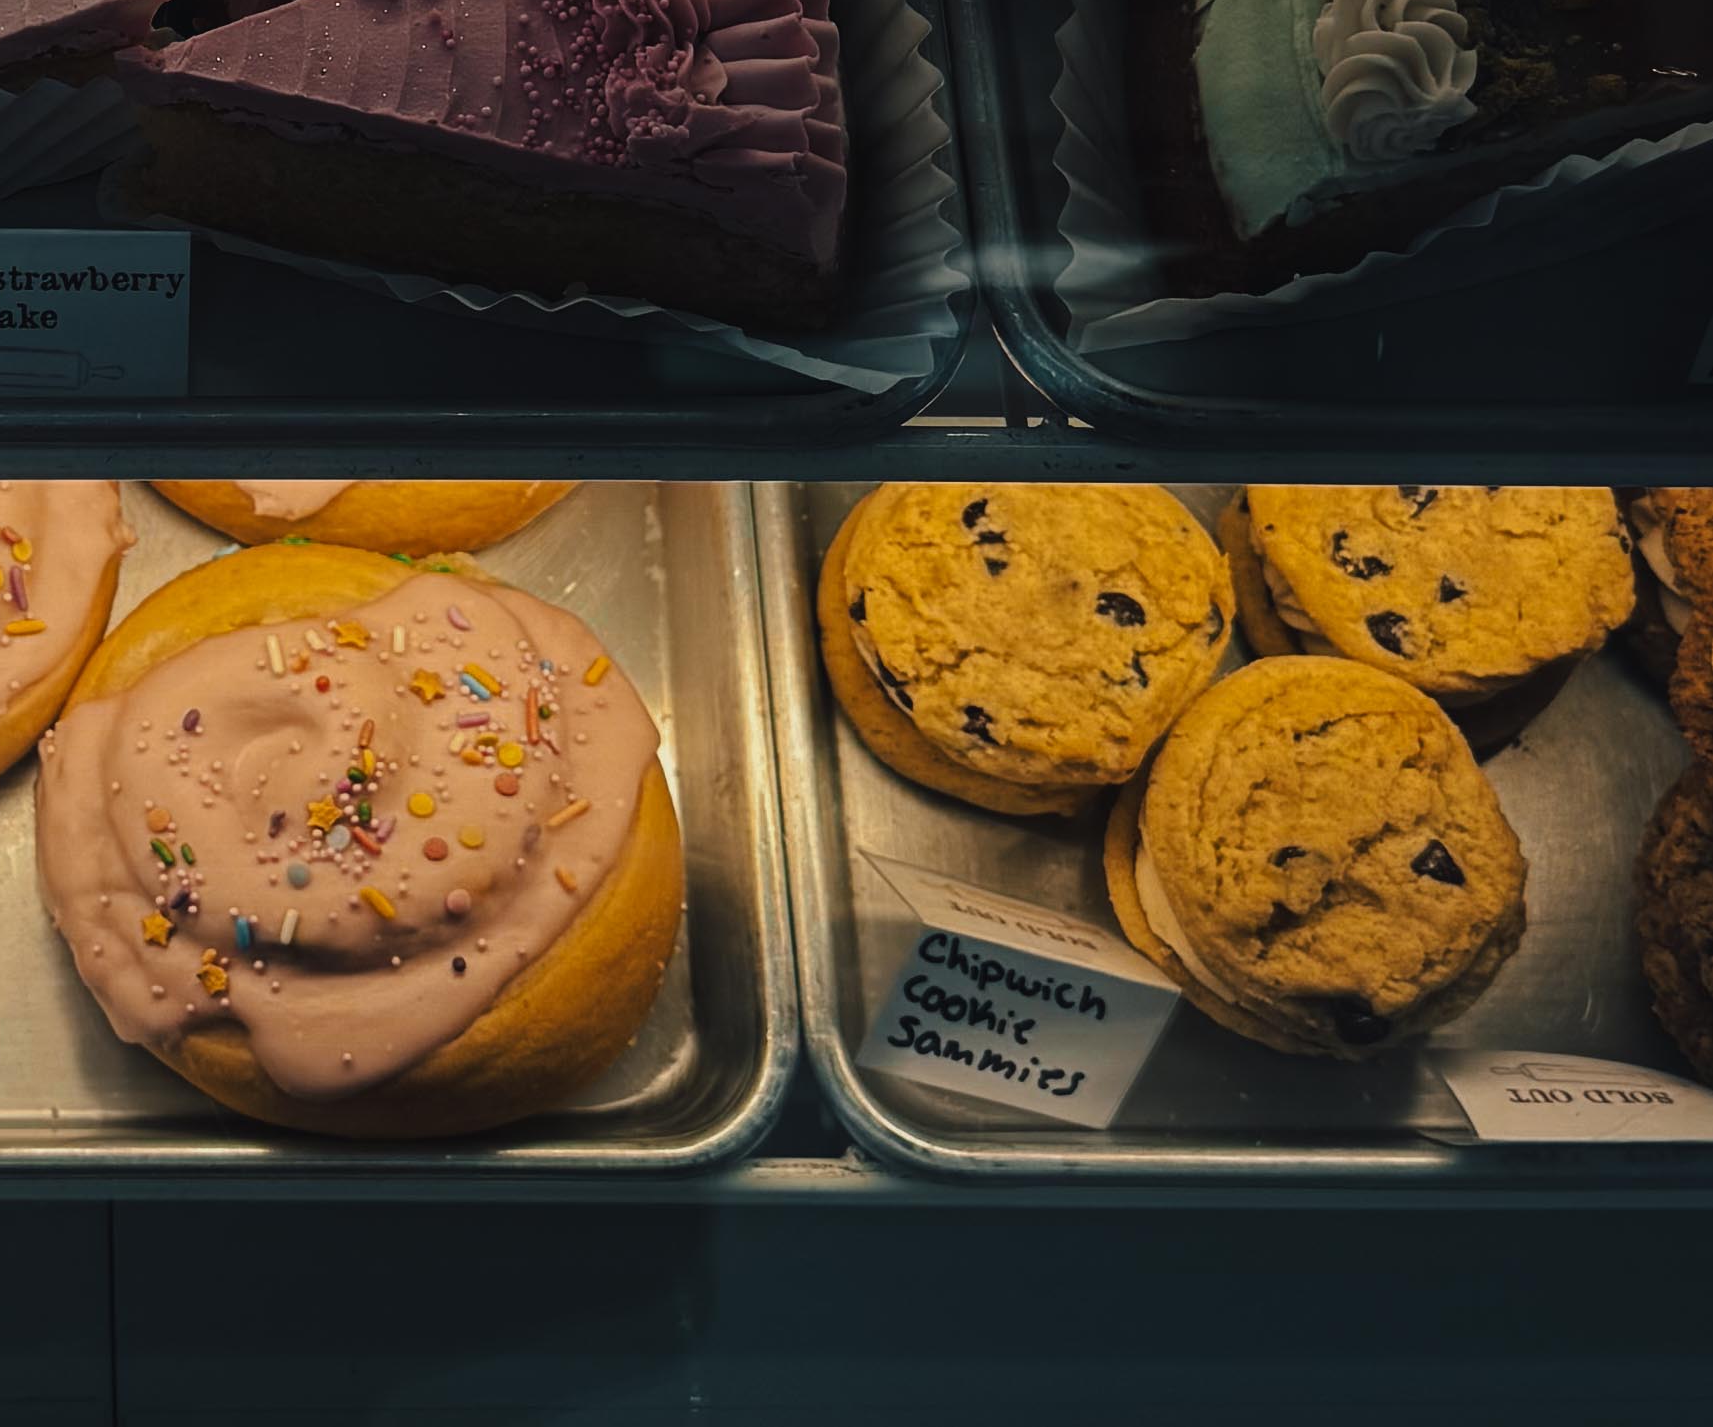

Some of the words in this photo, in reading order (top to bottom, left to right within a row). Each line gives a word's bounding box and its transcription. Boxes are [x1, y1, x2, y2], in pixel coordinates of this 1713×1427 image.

[918, 932, 1106, 1021] Chipwich
[888, 1015, 1085, 1096] Sammies
[1504, 1087, 1574, 1105] OUT
[1582, 1088, 1676, 1106] SOLD
